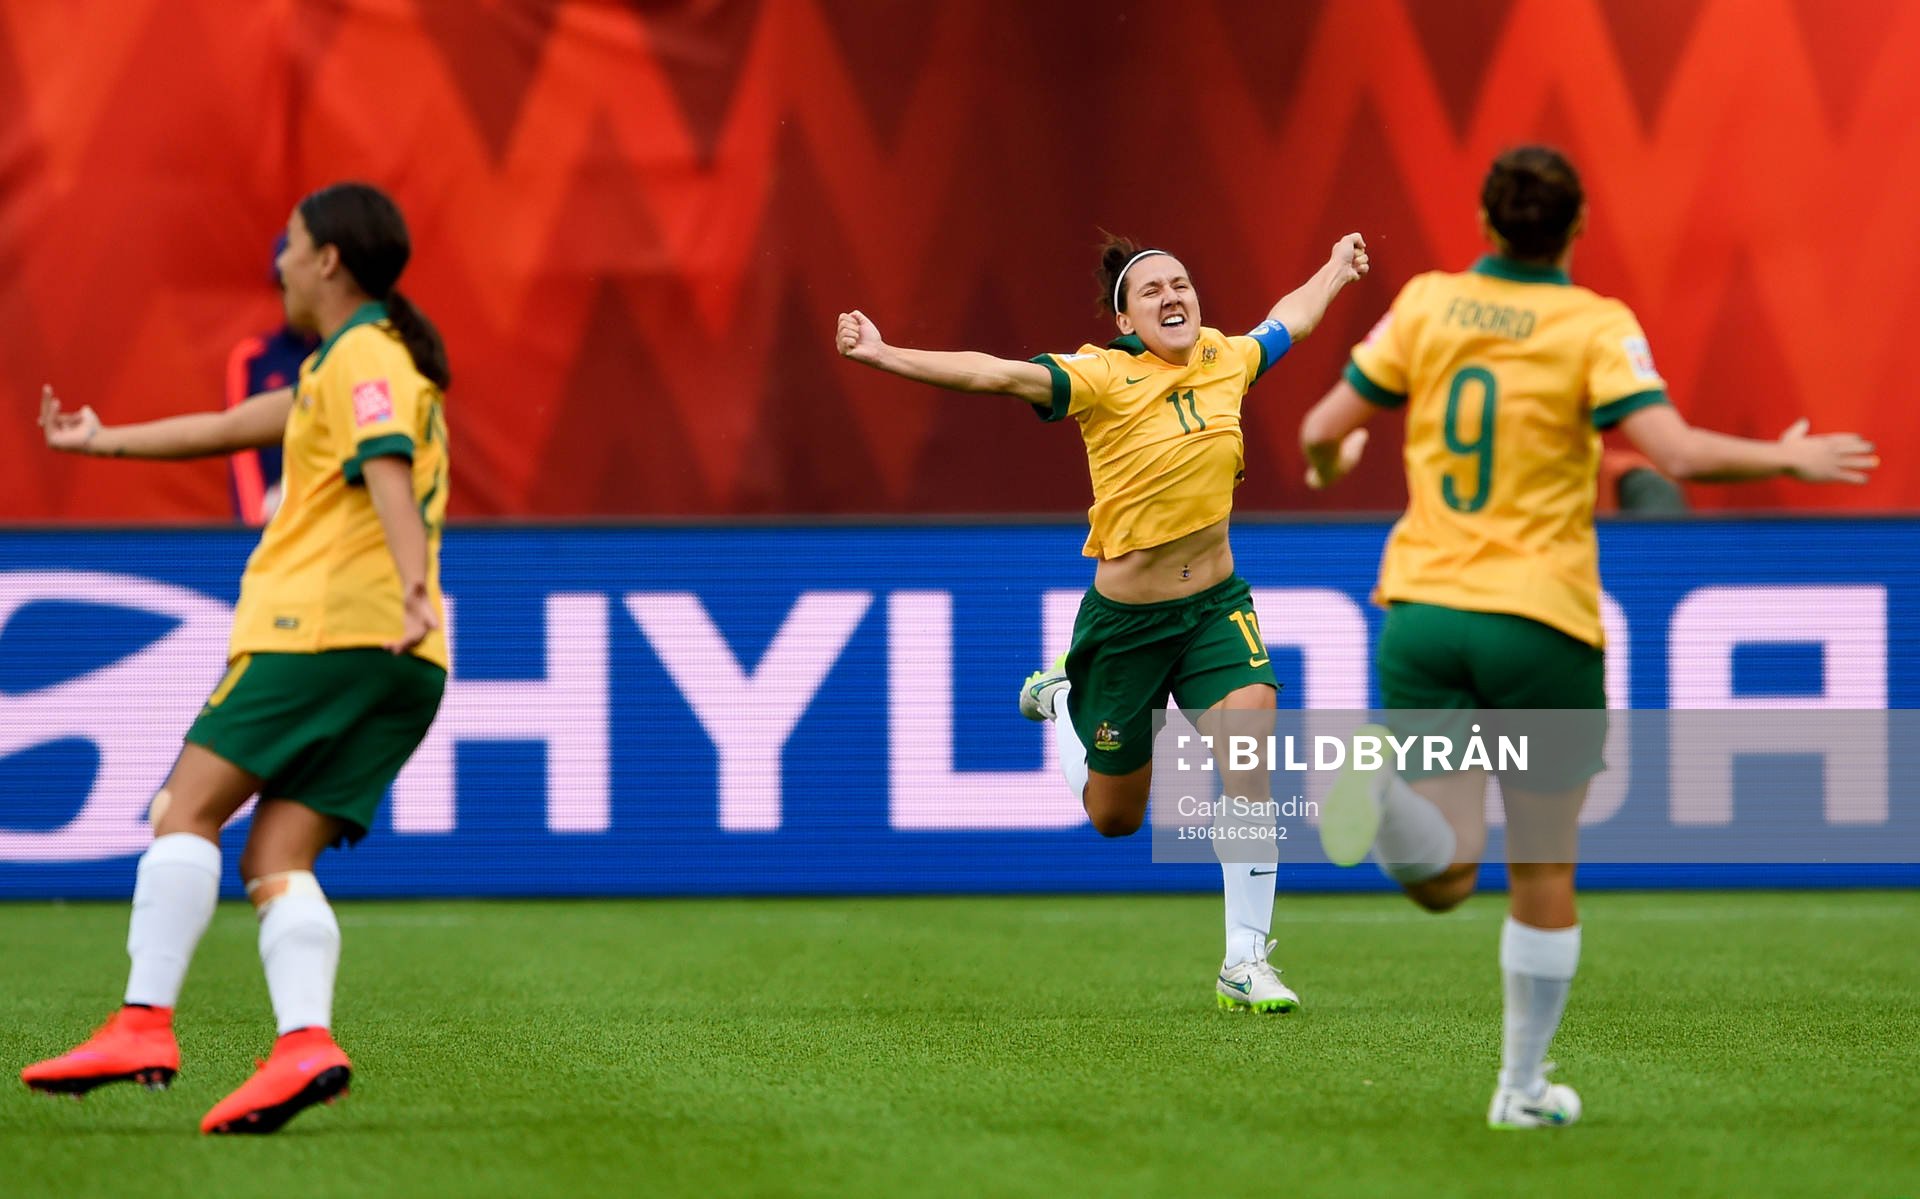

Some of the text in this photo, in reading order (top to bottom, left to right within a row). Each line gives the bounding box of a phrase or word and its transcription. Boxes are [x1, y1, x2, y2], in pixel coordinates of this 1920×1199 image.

[1443, 297, 1537, 339] FOORD
[1166, 389, 1207, 435] 11
[1441, 365, 1498, 513] 9
[1229, 610, 1268, 657] 11
[392, 585, 1890, 832] HYUNA
